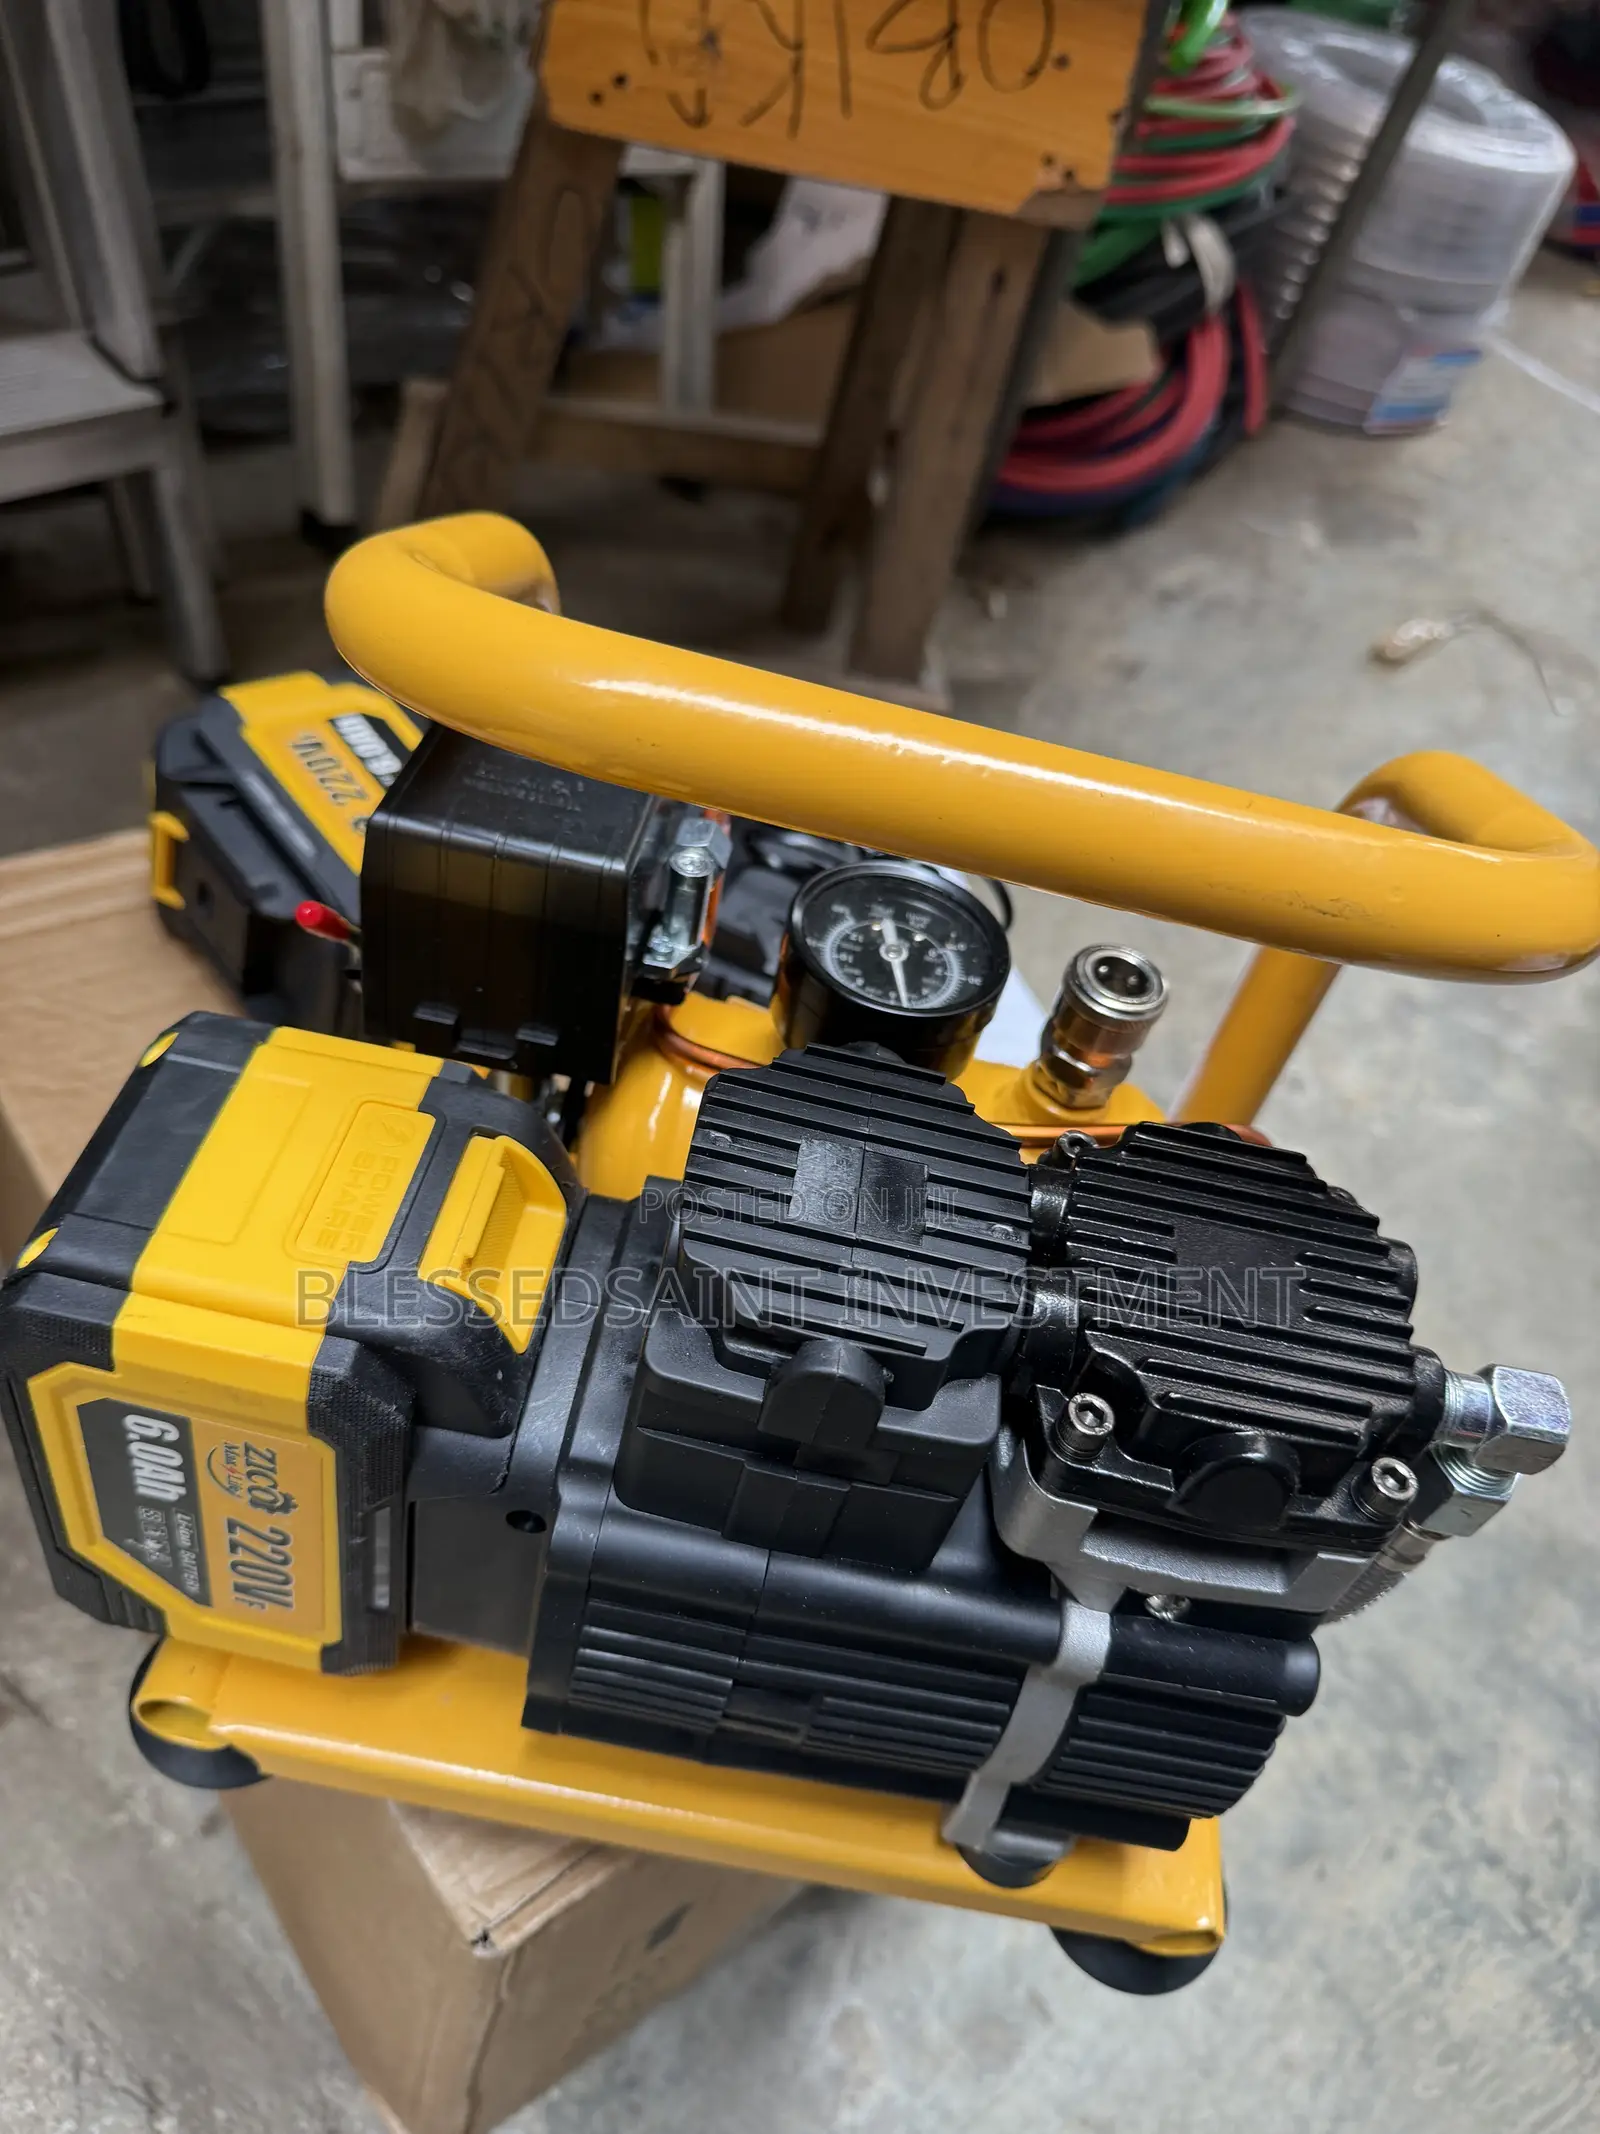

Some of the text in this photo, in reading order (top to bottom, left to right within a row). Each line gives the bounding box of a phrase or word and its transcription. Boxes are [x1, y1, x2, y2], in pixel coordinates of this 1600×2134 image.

[341, 1154, 401, 1254] POWER
[122, 1413, 188, 1503] 6.0Ah
[243, 1441, 290, 1511] ZICO
